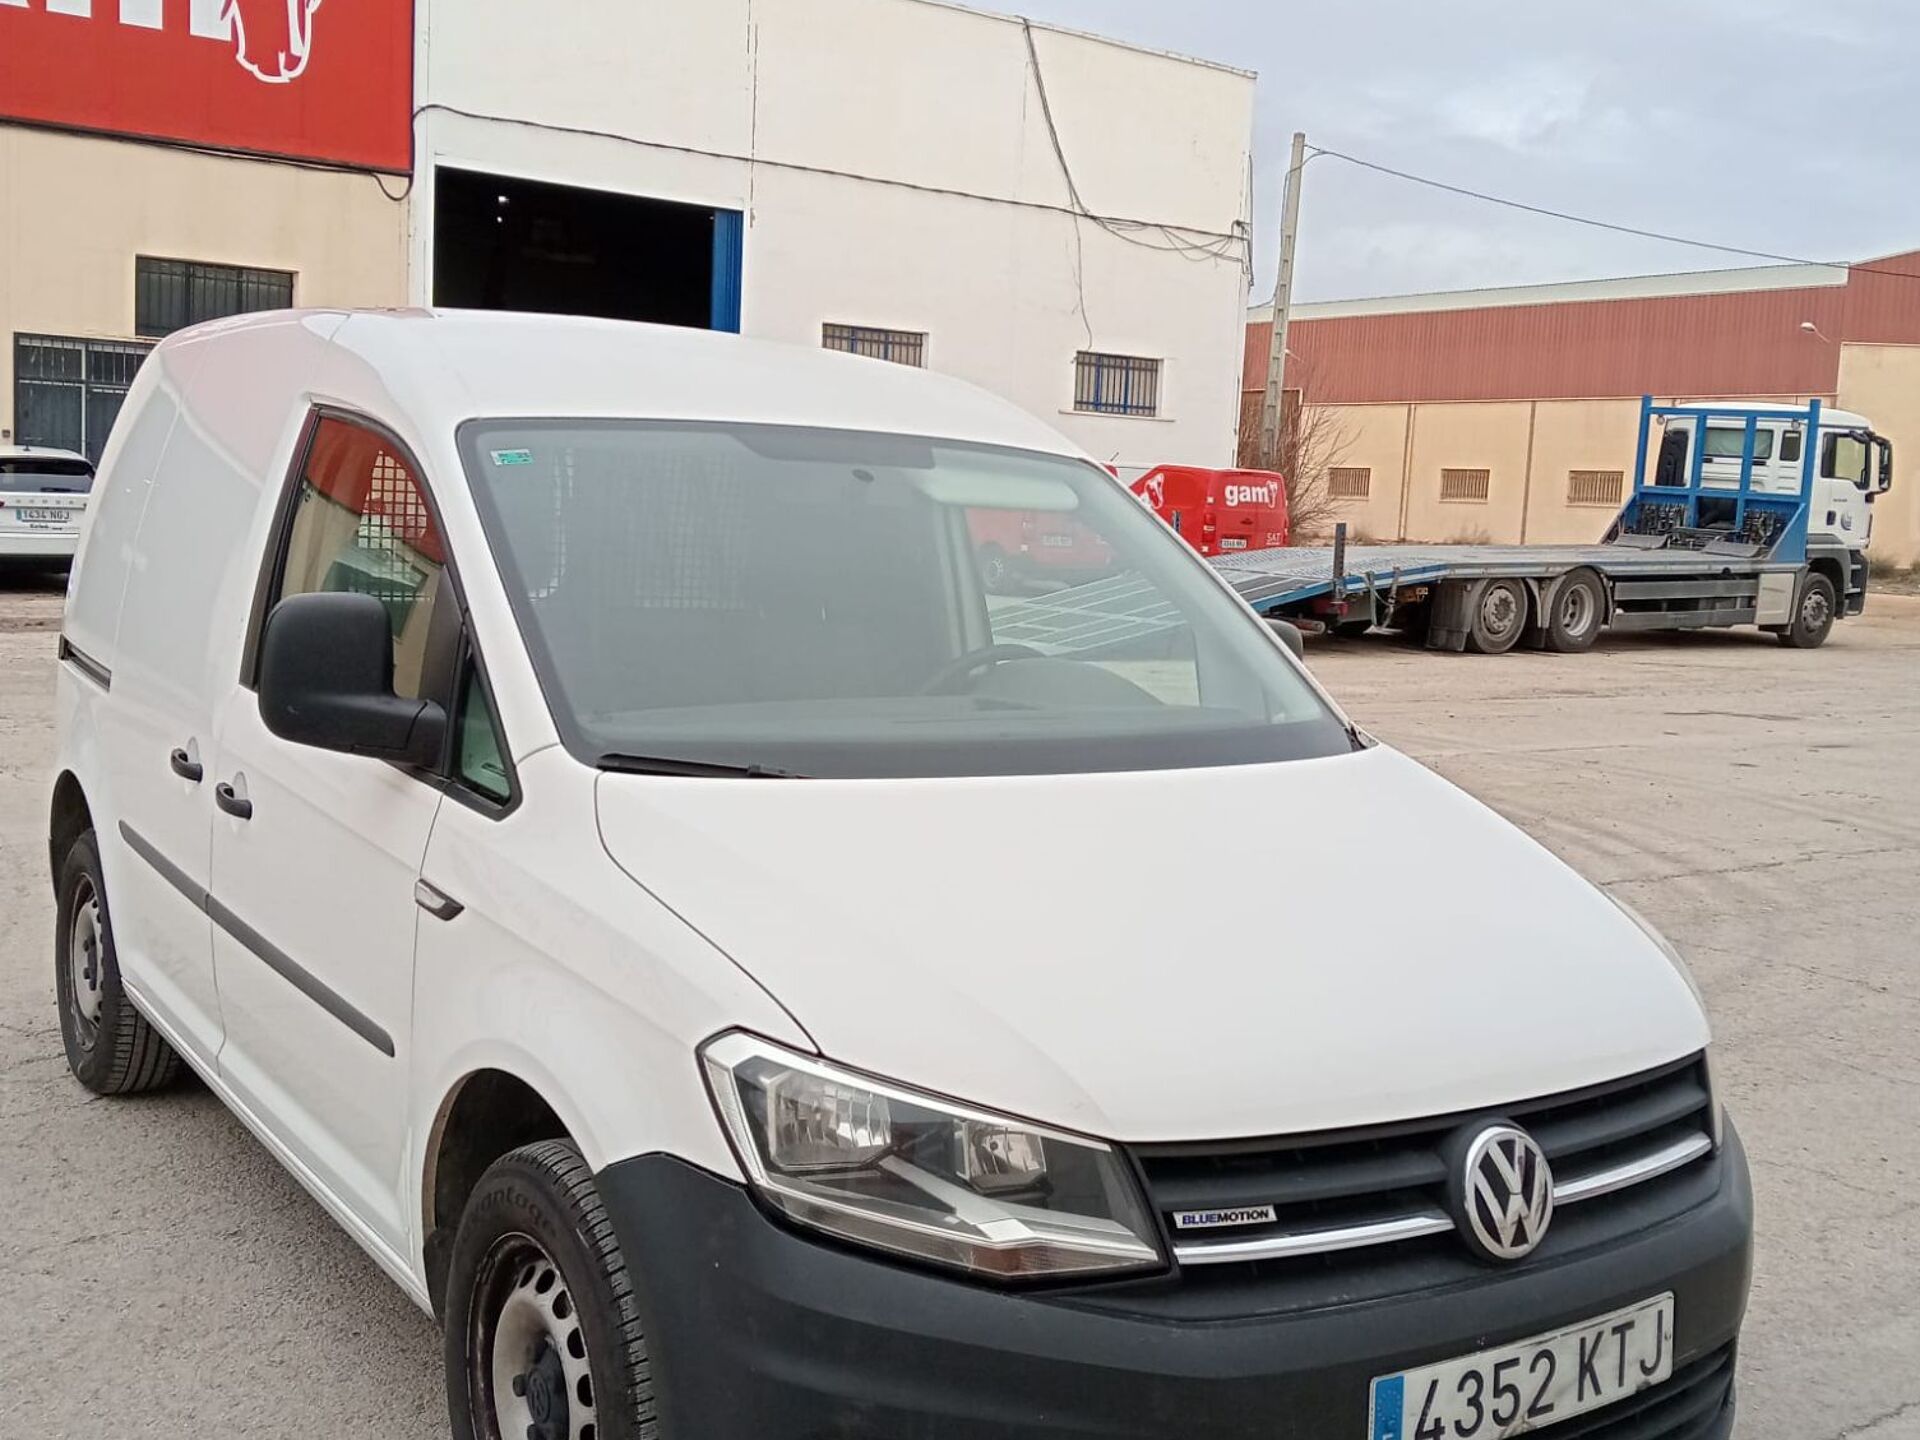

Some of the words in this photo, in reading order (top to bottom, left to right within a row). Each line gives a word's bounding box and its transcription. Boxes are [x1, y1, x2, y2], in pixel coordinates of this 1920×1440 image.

[1225, 485, 1270, 507] gam
[1183, 1209, 1269, 1225] BLUEMOTION
[1413, 1348, 1556, 1440] 4352
[1577, 1309, 1664, 1402] KTJ
